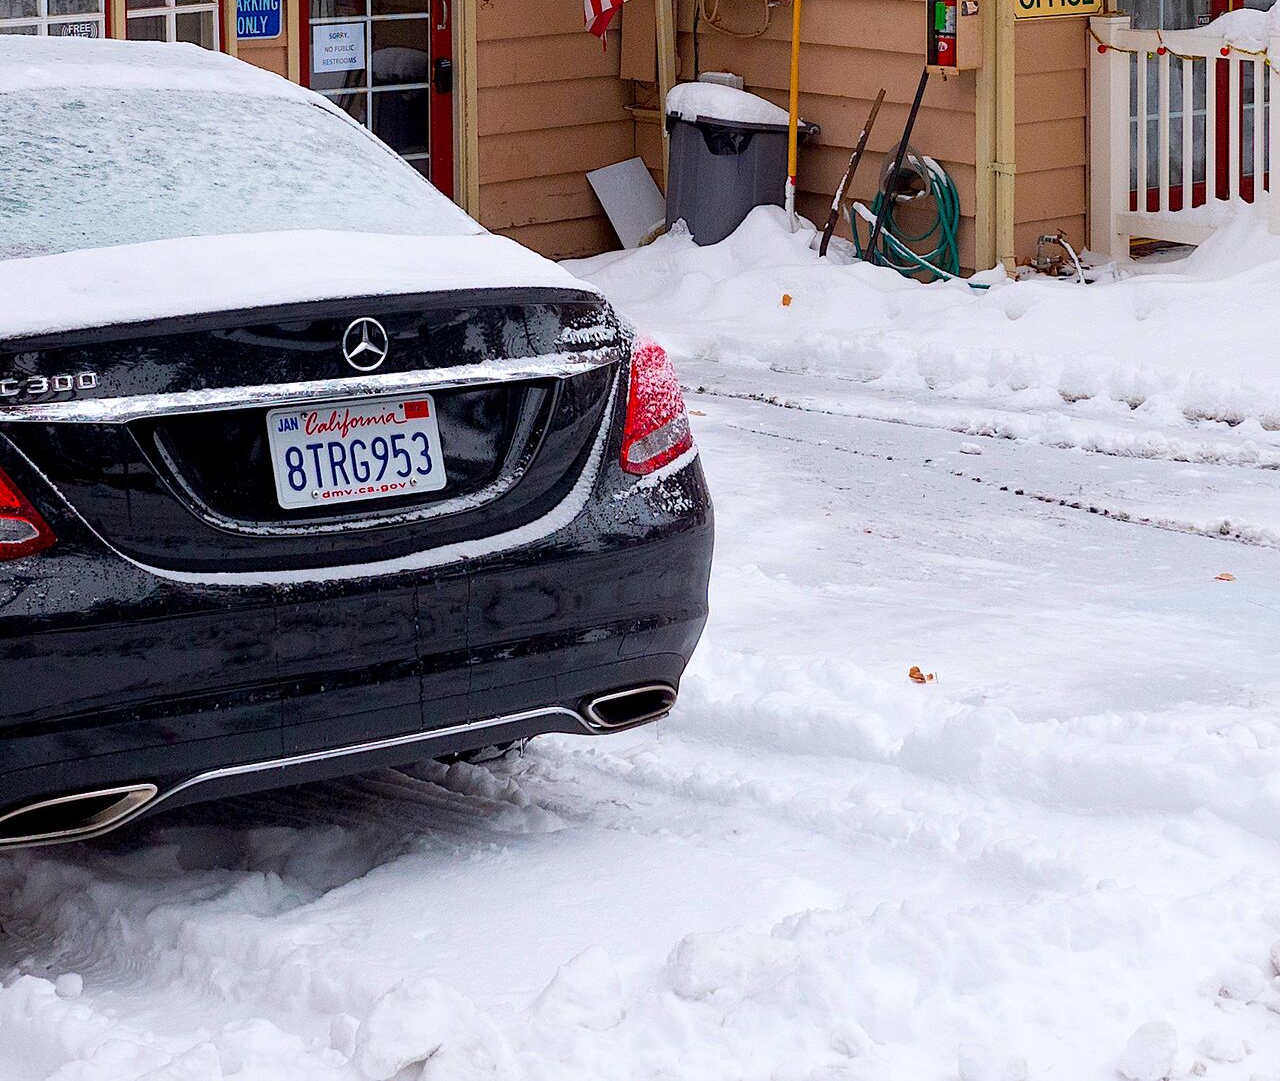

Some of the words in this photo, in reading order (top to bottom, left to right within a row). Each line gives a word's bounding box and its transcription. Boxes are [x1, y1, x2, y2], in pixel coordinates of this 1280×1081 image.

[68, 23, 91, 35] FREE
[237, 15, 268, 34] ONLY
[324, 45, 334, 53] NO
[334, 44, 355, 52] PUBLIC
[322, 56, 357, 65] RESTROOMS
[278, 416, 299, 432] JAN
[305, 407, 408, 438] California
[285, 431, 433, 491] 8TRG953
[322, 481, 407, 499] dmv.ca.gov
